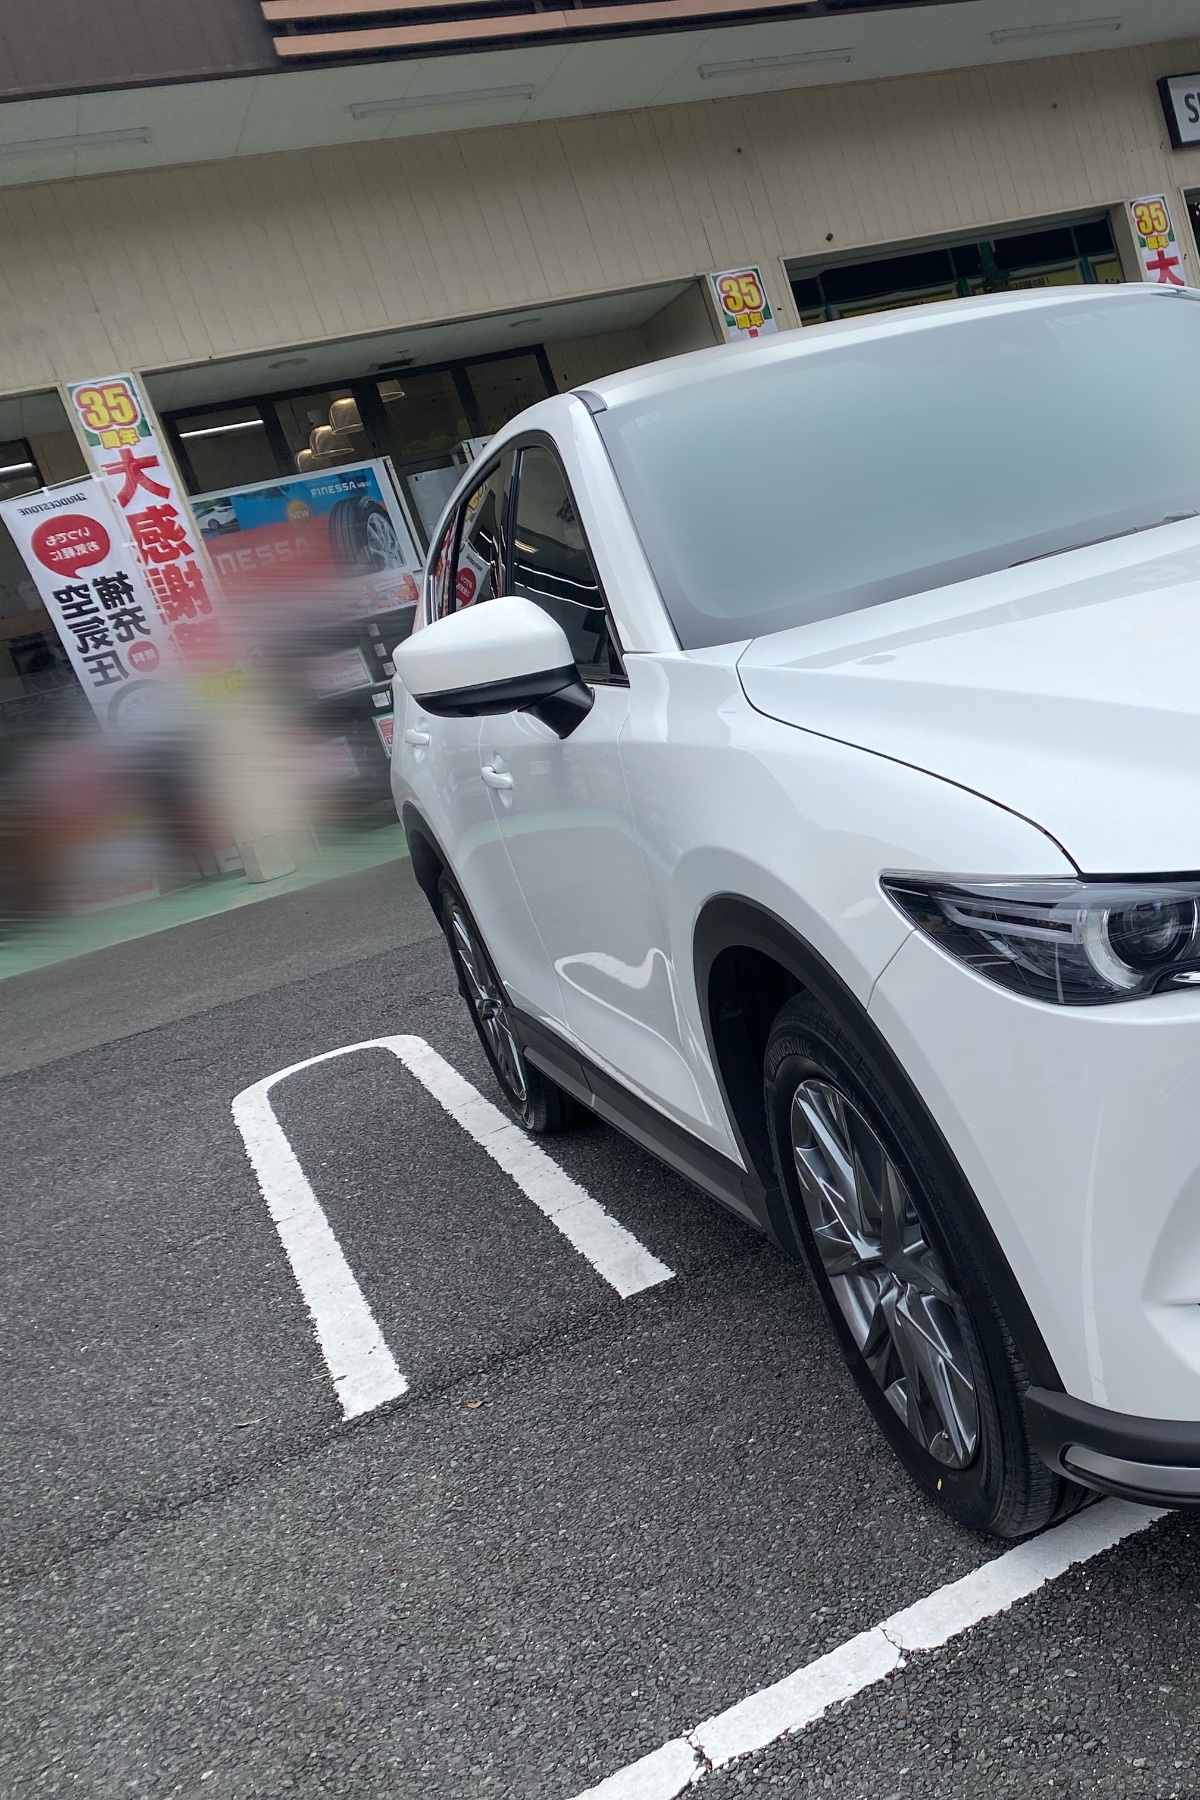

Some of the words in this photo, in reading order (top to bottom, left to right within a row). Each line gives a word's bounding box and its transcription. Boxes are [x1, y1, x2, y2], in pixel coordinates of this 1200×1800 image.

[1134, 201, 1168, 235] 35
[719, 273, 763, 313] 35
[76, 383, 136, 430] 35
[99, 427, 140, 449] 周年
[310, 481, 357, 498] FINESSA
[289, 509, 309, 520] NEW
[216, 537, 312, 576] NESSA
